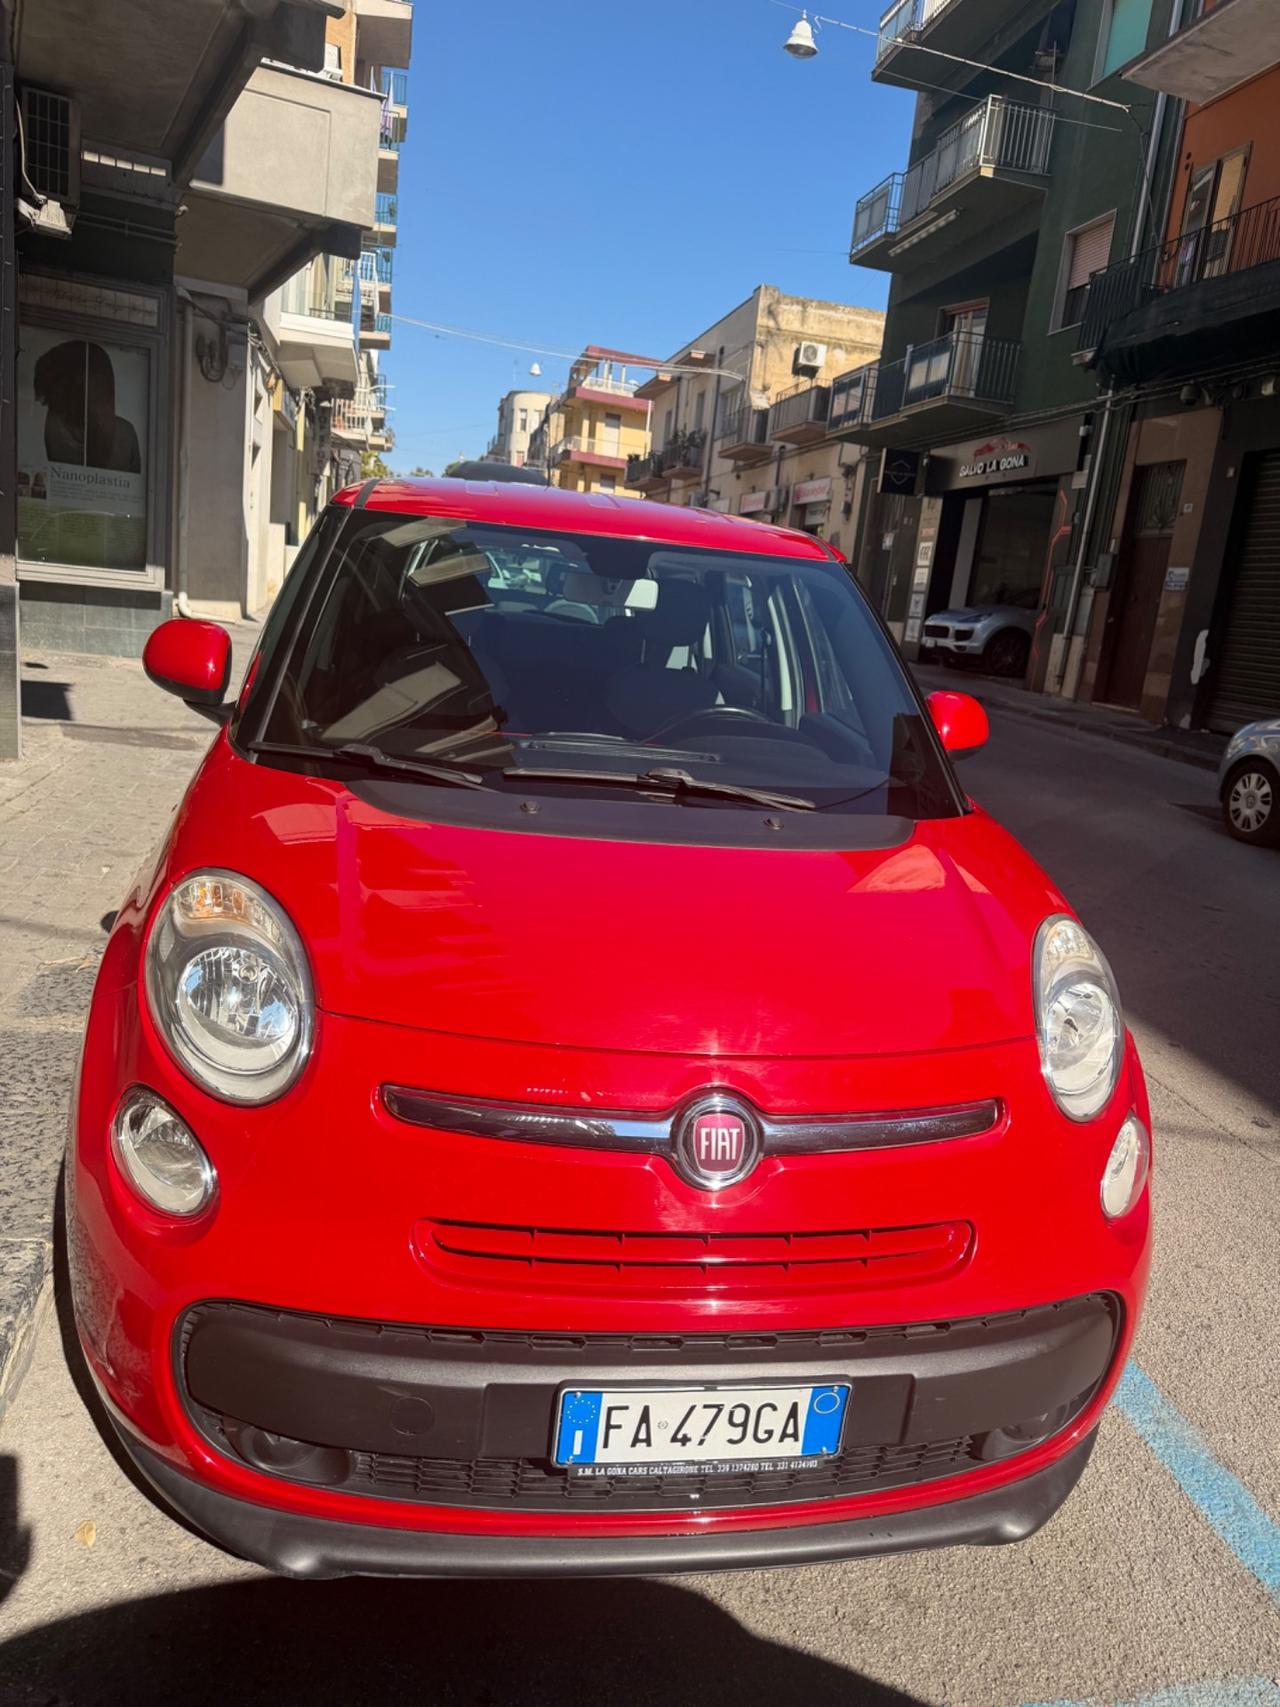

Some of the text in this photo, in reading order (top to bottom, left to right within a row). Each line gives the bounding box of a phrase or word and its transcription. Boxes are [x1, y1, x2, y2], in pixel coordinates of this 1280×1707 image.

[959, 454, 1025, 477] SALVO LA GONA
[50, 466, 130, 489] Nanoplastia
[701, 1127, 740, 1160] FIAT
[595, 1467, 606, 1476] LA
[606, 1467, 627, 1476] GONA
[628, 1466, 648, 1475] CARS
[648, 1464, 699, 1475] CALTAGIRONE
